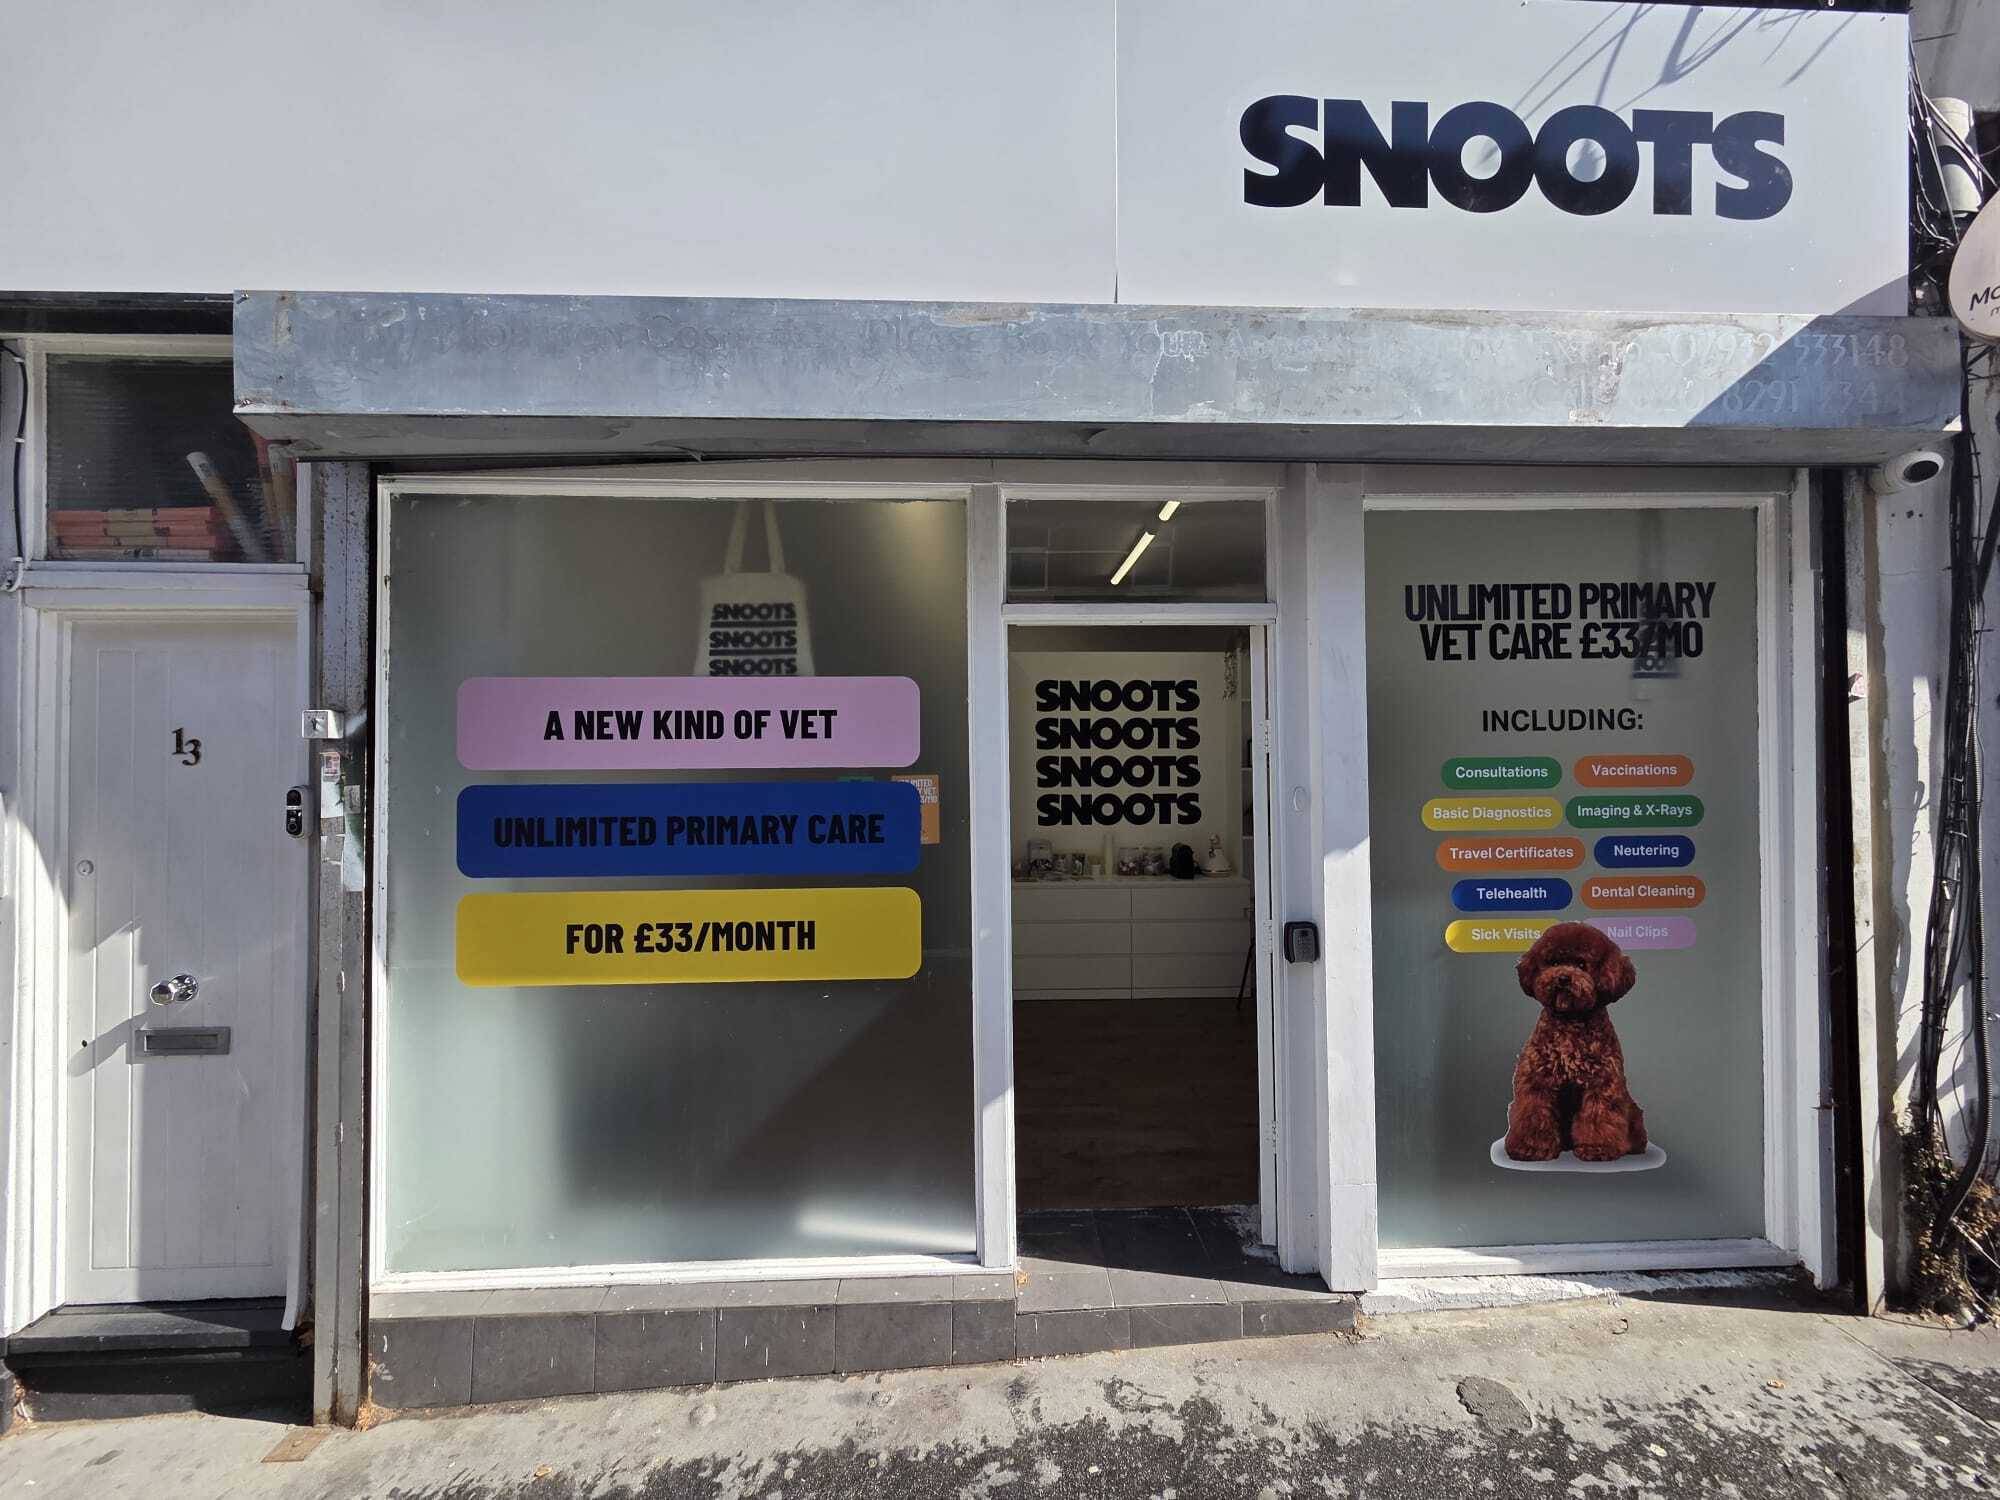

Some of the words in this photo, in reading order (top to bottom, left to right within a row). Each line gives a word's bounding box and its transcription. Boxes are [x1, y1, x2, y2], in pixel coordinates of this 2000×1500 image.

[1240, 94, 1793, 221] SNOOTS
[711, 602, 796, 620] SNOOTS
[1404, 583, 1572, 621] UNLIMITED
[1579, 582, 1716, 619] PRIMARY
[709, 630, 797, 648] SNOOTS
[1419, 623, 1482, 660] VET
[1488, 622, 1572, 659] CARE
[709, 658, 797, 677] SNOOTS
[1035, 680, 1200, 712] SNOOTS
[544, 710, 565, 741] A
[574, 710, 644, 741] NEW
[652, 710, 725, 740] KIND
[734, 710, 771, 739] OF
[780, 710, 837, 739] VET
[1482, 708, 1643, 732] INCLUDING:
[1035, 717, 1201, 750] SNOOTS
[171, 728, 202, 766] 13
[1036, 755, 1201, 788] SNOOTS
[1455, 766, 1549, 779] Consultations
[1591, 764, 1678, 777] Vaccinations
[1036, 792, 1202, 826] SNOOTS
[1433, 807, 1469, 820] Basic
[1472, 806, 1552, 822] Diagnostics
[1577, 804, 1631, 819] Imaging
[1633, 805, 1643, 816] &
[1646, 804, 1693, 818] X-Rays
[494, 816, 656, 848] UNLIMITED
[666, 815, 799, 846] PRIMARY
[808, 814, 885, 844] CARE
[1450, 847, 1492, 860] Travel
[1495, 846, 1575, 859] Certificates
[1614, 844, 1680, 859] Neutering
[1476, 886, 1547, 899] Telehealth
[1591, 885, 1634, 898] Dental
[1637, 884, 1696, 899] Cleaning
[566, 924, 624, 954] FOR
[634, 920, 816, 953] £33/MONTH
[1471, 927, 1500, 941] Sick
[1503, 927, 1541, 940] Visits
[1607, 925, 1632, 939] Nail
[1635, 925, 1669, 940] Clips
